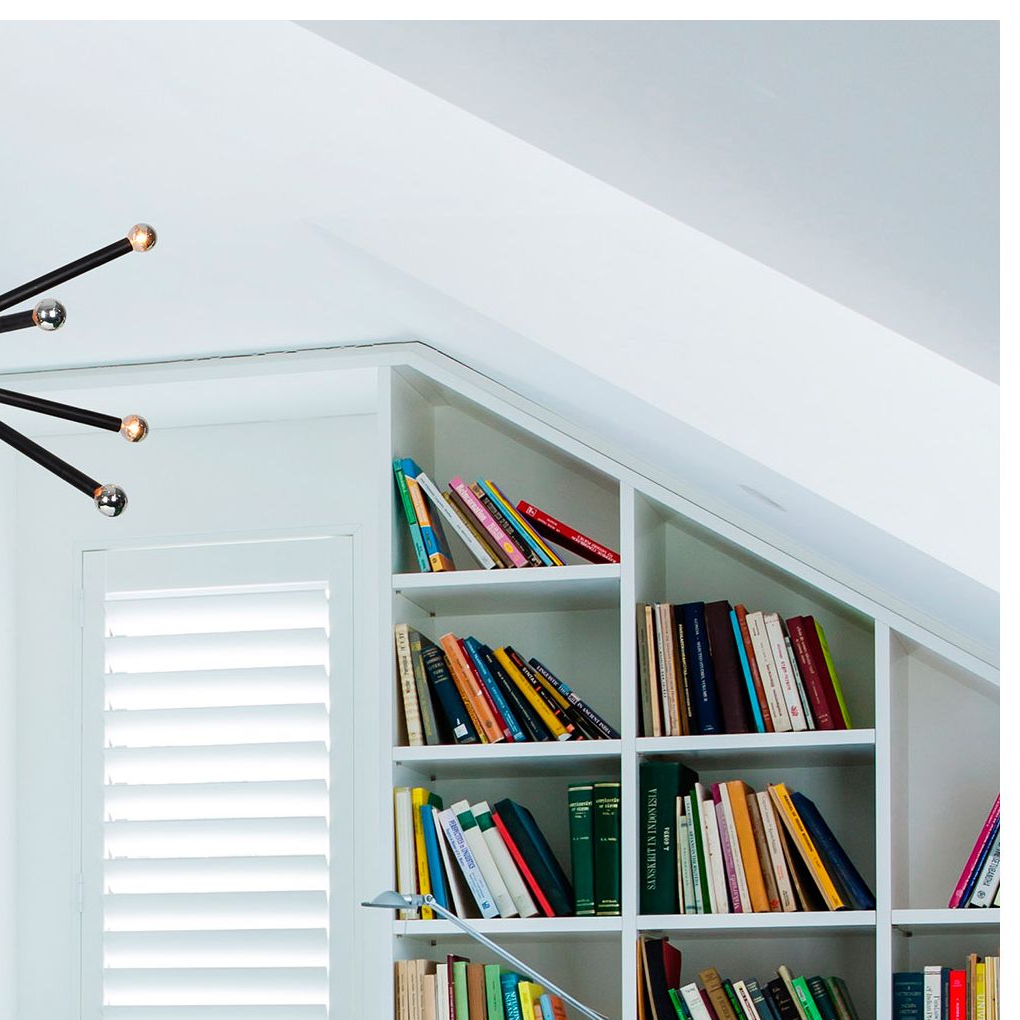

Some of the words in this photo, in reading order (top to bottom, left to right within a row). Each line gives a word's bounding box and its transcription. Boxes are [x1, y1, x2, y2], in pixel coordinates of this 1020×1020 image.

[453, 481, 488, 524] Reincarnation
[520, 665, 538, 686] SYNTAX
[536, 661, 561, 689] LINGUISTIC
[575, 700, 585, 710] IN
[580, 704, 601, 726] ANCIENT
[597, 720, 612, 736] INDIA
[644, 787, 658, 834] INDONESIA
[446, 818, 465, 845] PERSPECTIVES
[459, 845, 477, 870] LINGUISTICS
[645, 834, 657, 846] IN
[662, 826, 670, 844] GONDA
[644, 847, 657, 890] SANSKRIT
[505, 993, 514, 1015] INDIAN
